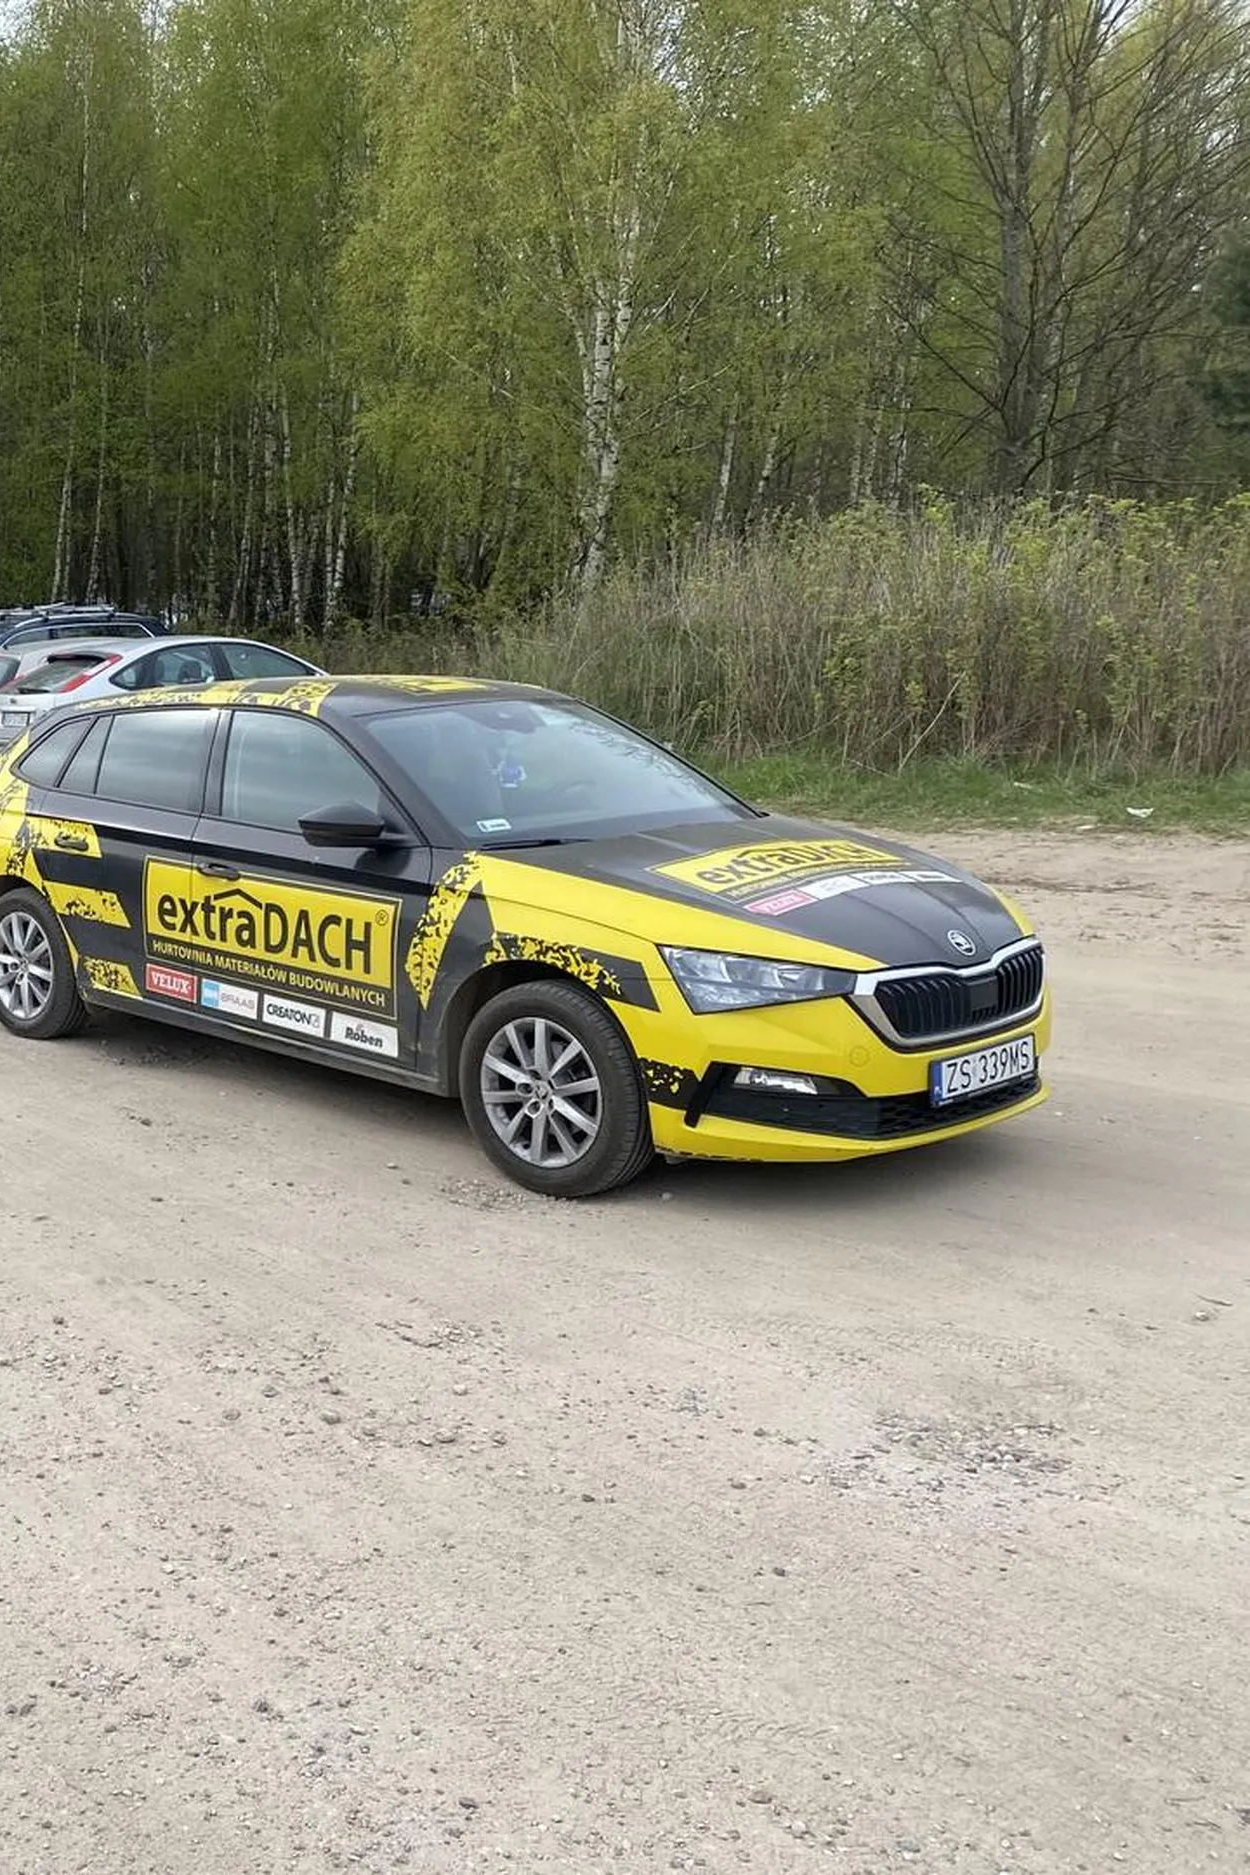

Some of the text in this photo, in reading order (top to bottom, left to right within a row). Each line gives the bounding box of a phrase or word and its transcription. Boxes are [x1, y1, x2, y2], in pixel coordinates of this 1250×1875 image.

[151, 971, 190, 994] VELUX
[153, 939, 385, 1007] HURTOWNIA MATERIAŁÓW BUDOWLANYCH
[946, 1060, 971, 1093] ZS
[979, 1042, 1029, 1084] 339MS
